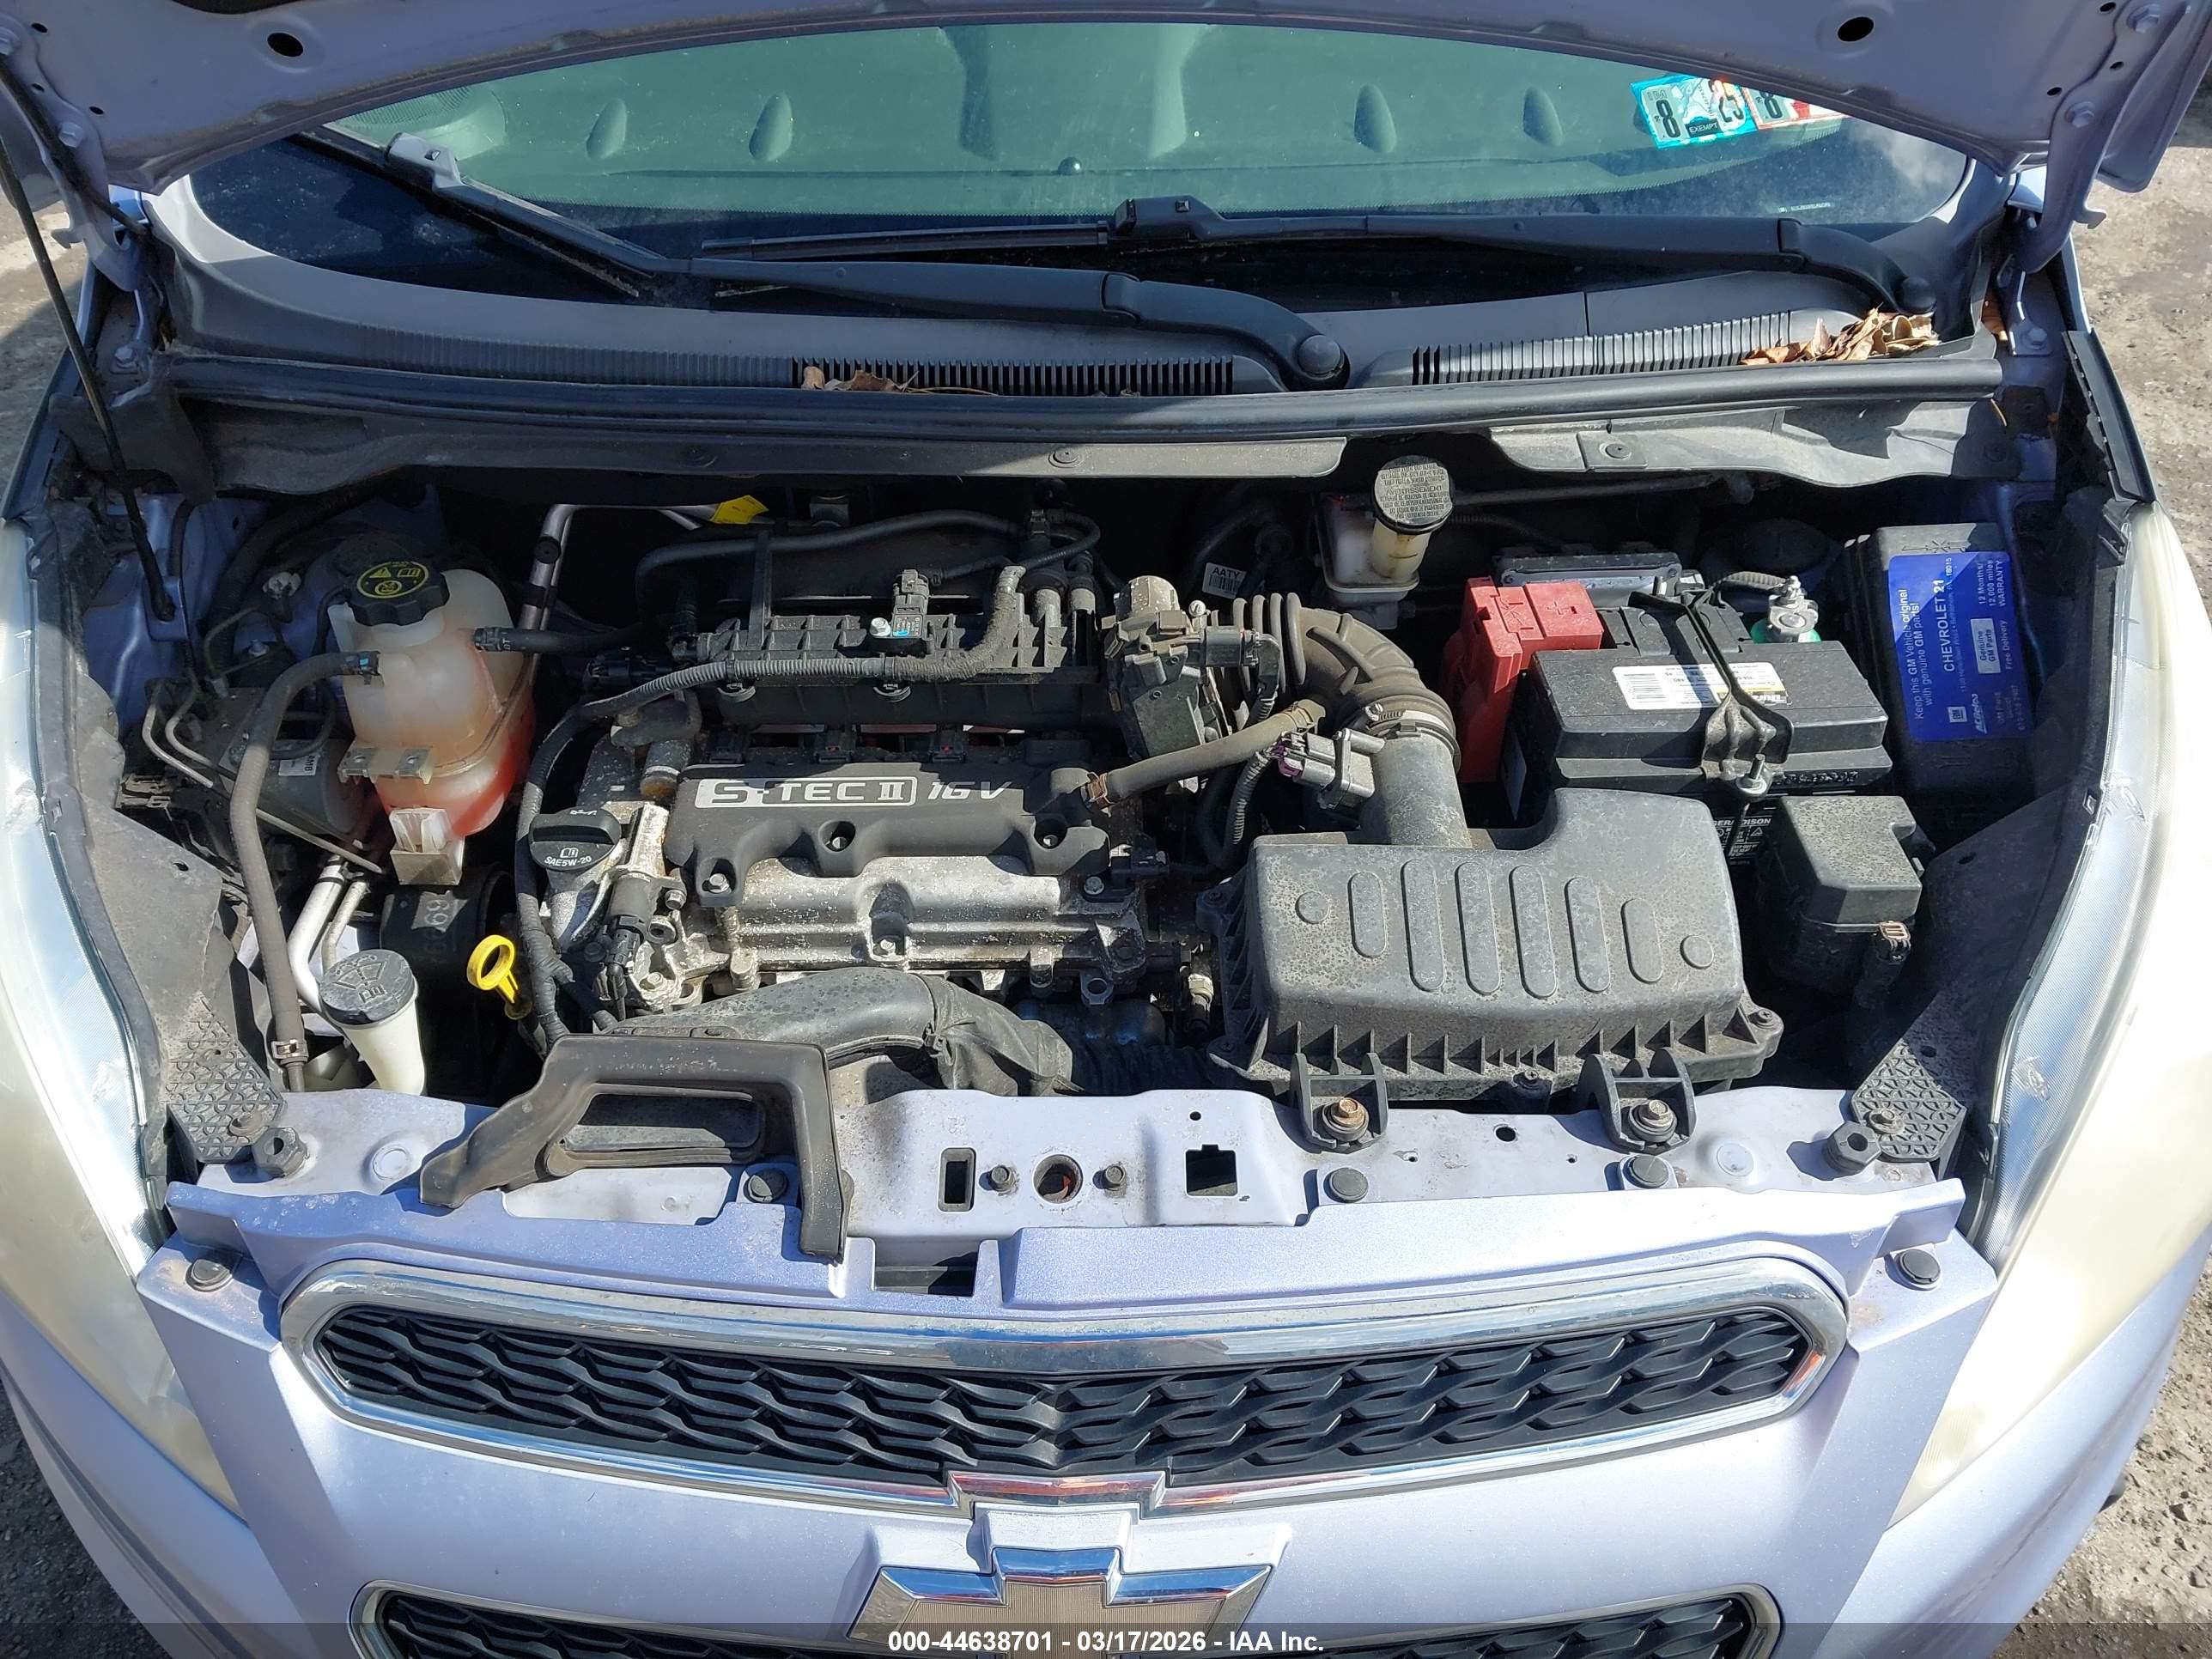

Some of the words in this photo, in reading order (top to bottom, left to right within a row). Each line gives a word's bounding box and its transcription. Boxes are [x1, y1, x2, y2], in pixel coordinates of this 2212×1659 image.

[1656, 99, 1681, 138] 8
[1689, 122, 1718, 133] EXEMPT
[1212, 567, 1241, 580] AATY
[1976, 562, 1984, 594] Months/
[1996, 560, 2007, 607] WARRANTY
[1933, 580, 1945, 592] 21
[1898, 589, 1911, 623] original
[1979, 596, 1985, 605] 12
[1911, 603, 1923, 629] parts!
[1903, 625, 1915, 657] Vehicle
[1914, 631, 1923, 646] GM
[1936, 597, 1955, 672] CHEVROLET
[1978, 630, 1986, 661] Genuine
[1984, 629, 1994, 647] Parts
[1999, 620, 2011, 651] Delivery
[1908, 659, 1917, 674] GM
[1918, 650, 1932, 684] genuine
[1987, 649, 1996, 662] GM
[2004, 653, 2013, 670] Free
[1911, 678, 1920, 693] this
[1923, 687, 1932, 705] with
[1914, 696, 1924, 719] Keep
[1971, 693, 1984, 732] ACDelco
[711, 781, 867, 804] S-TEC
[877, 781, 906, 802] II
[927, 781, 1013, 800] 16V
[544, 855, 592, 867] SAE5W-20
